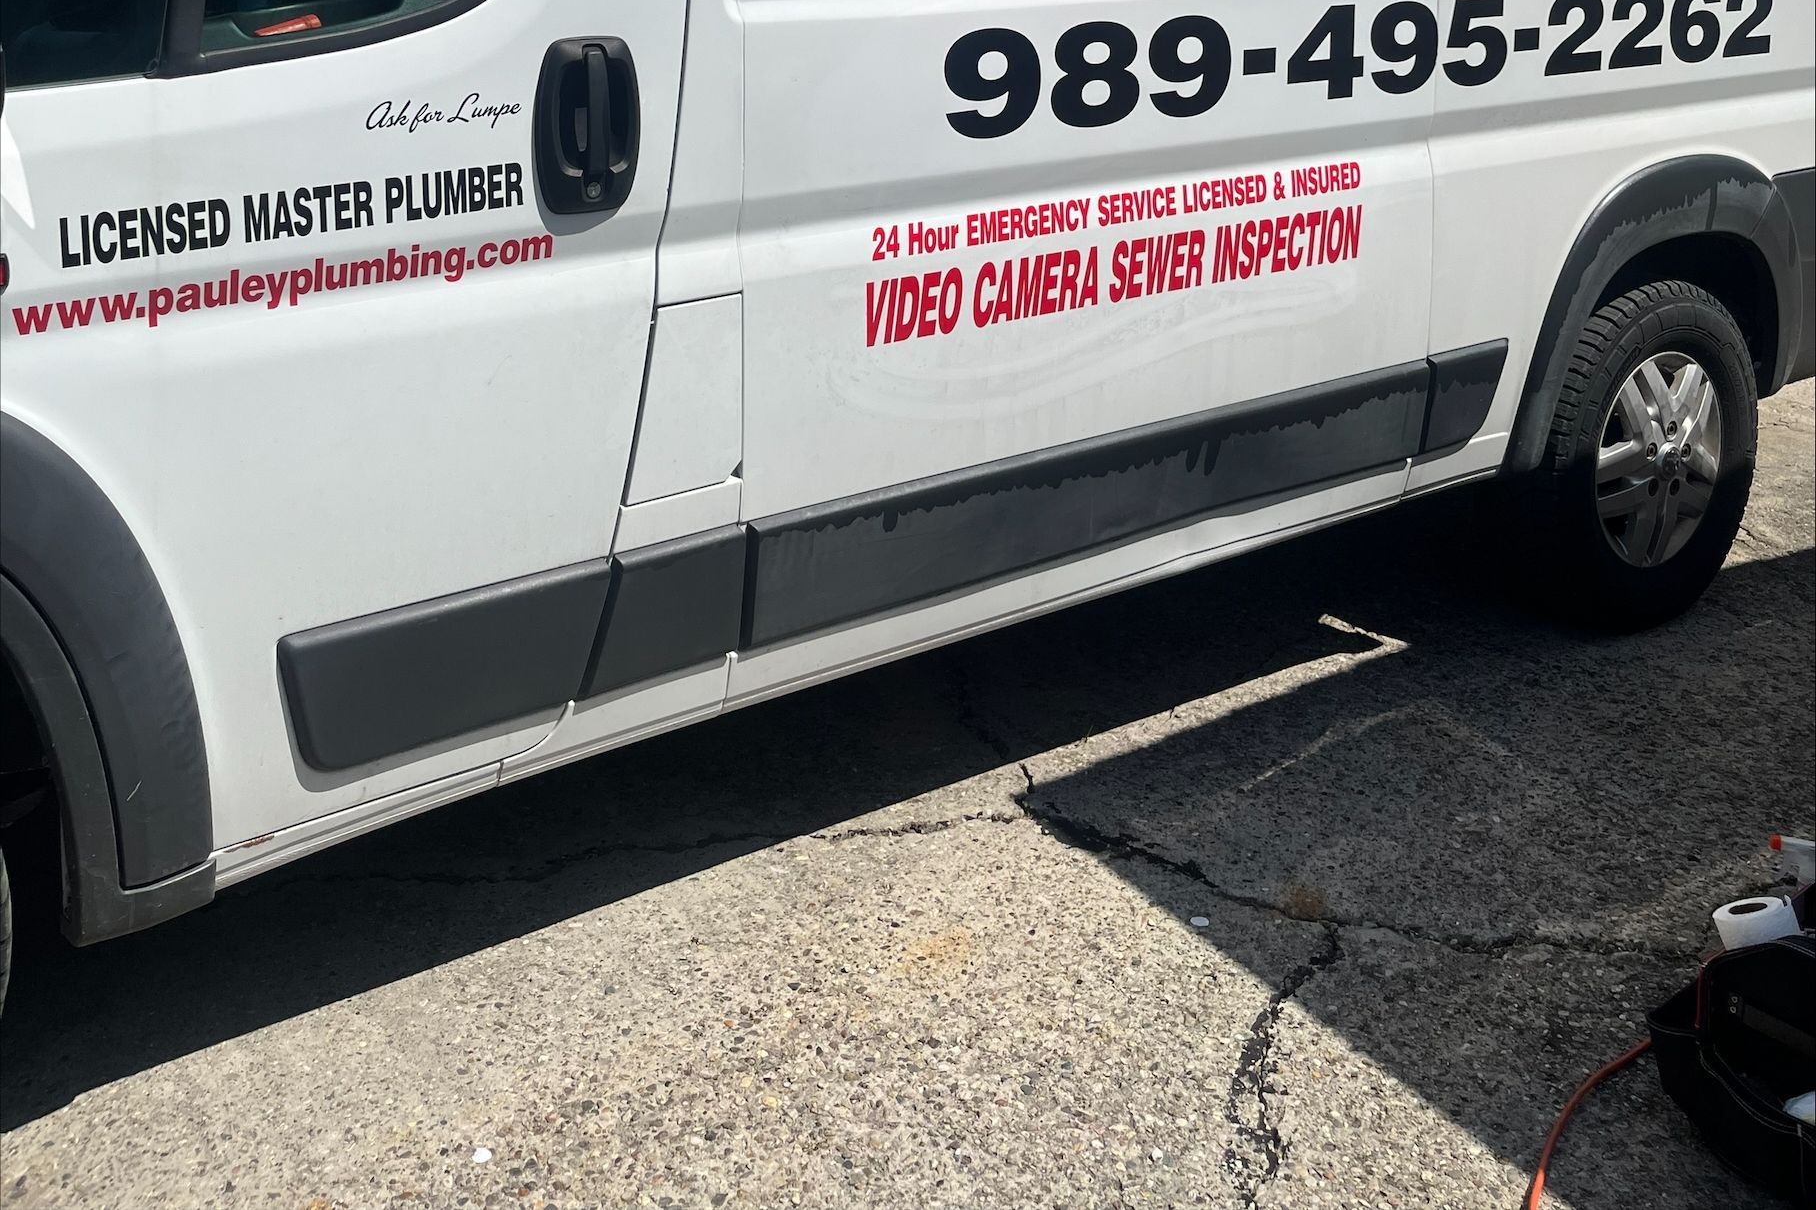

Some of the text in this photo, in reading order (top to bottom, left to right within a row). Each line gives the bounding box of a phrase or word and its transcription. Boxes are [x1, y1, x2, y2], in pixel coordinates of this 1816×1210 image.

[365, 92, 522, 133] Ask for Lumpe
[58, 162, 525, 270] LICENSED MASTER PLUMBER
[871, 161, 1362, 262] 24 Hour EMERGENCY SERVICE LICENSED & INSURED
[12, 233, 554, 336] www.pauleyplumbing.com
[865, 205, 1363, 347] VIDEO CAMERA SEWER INSPECTION
